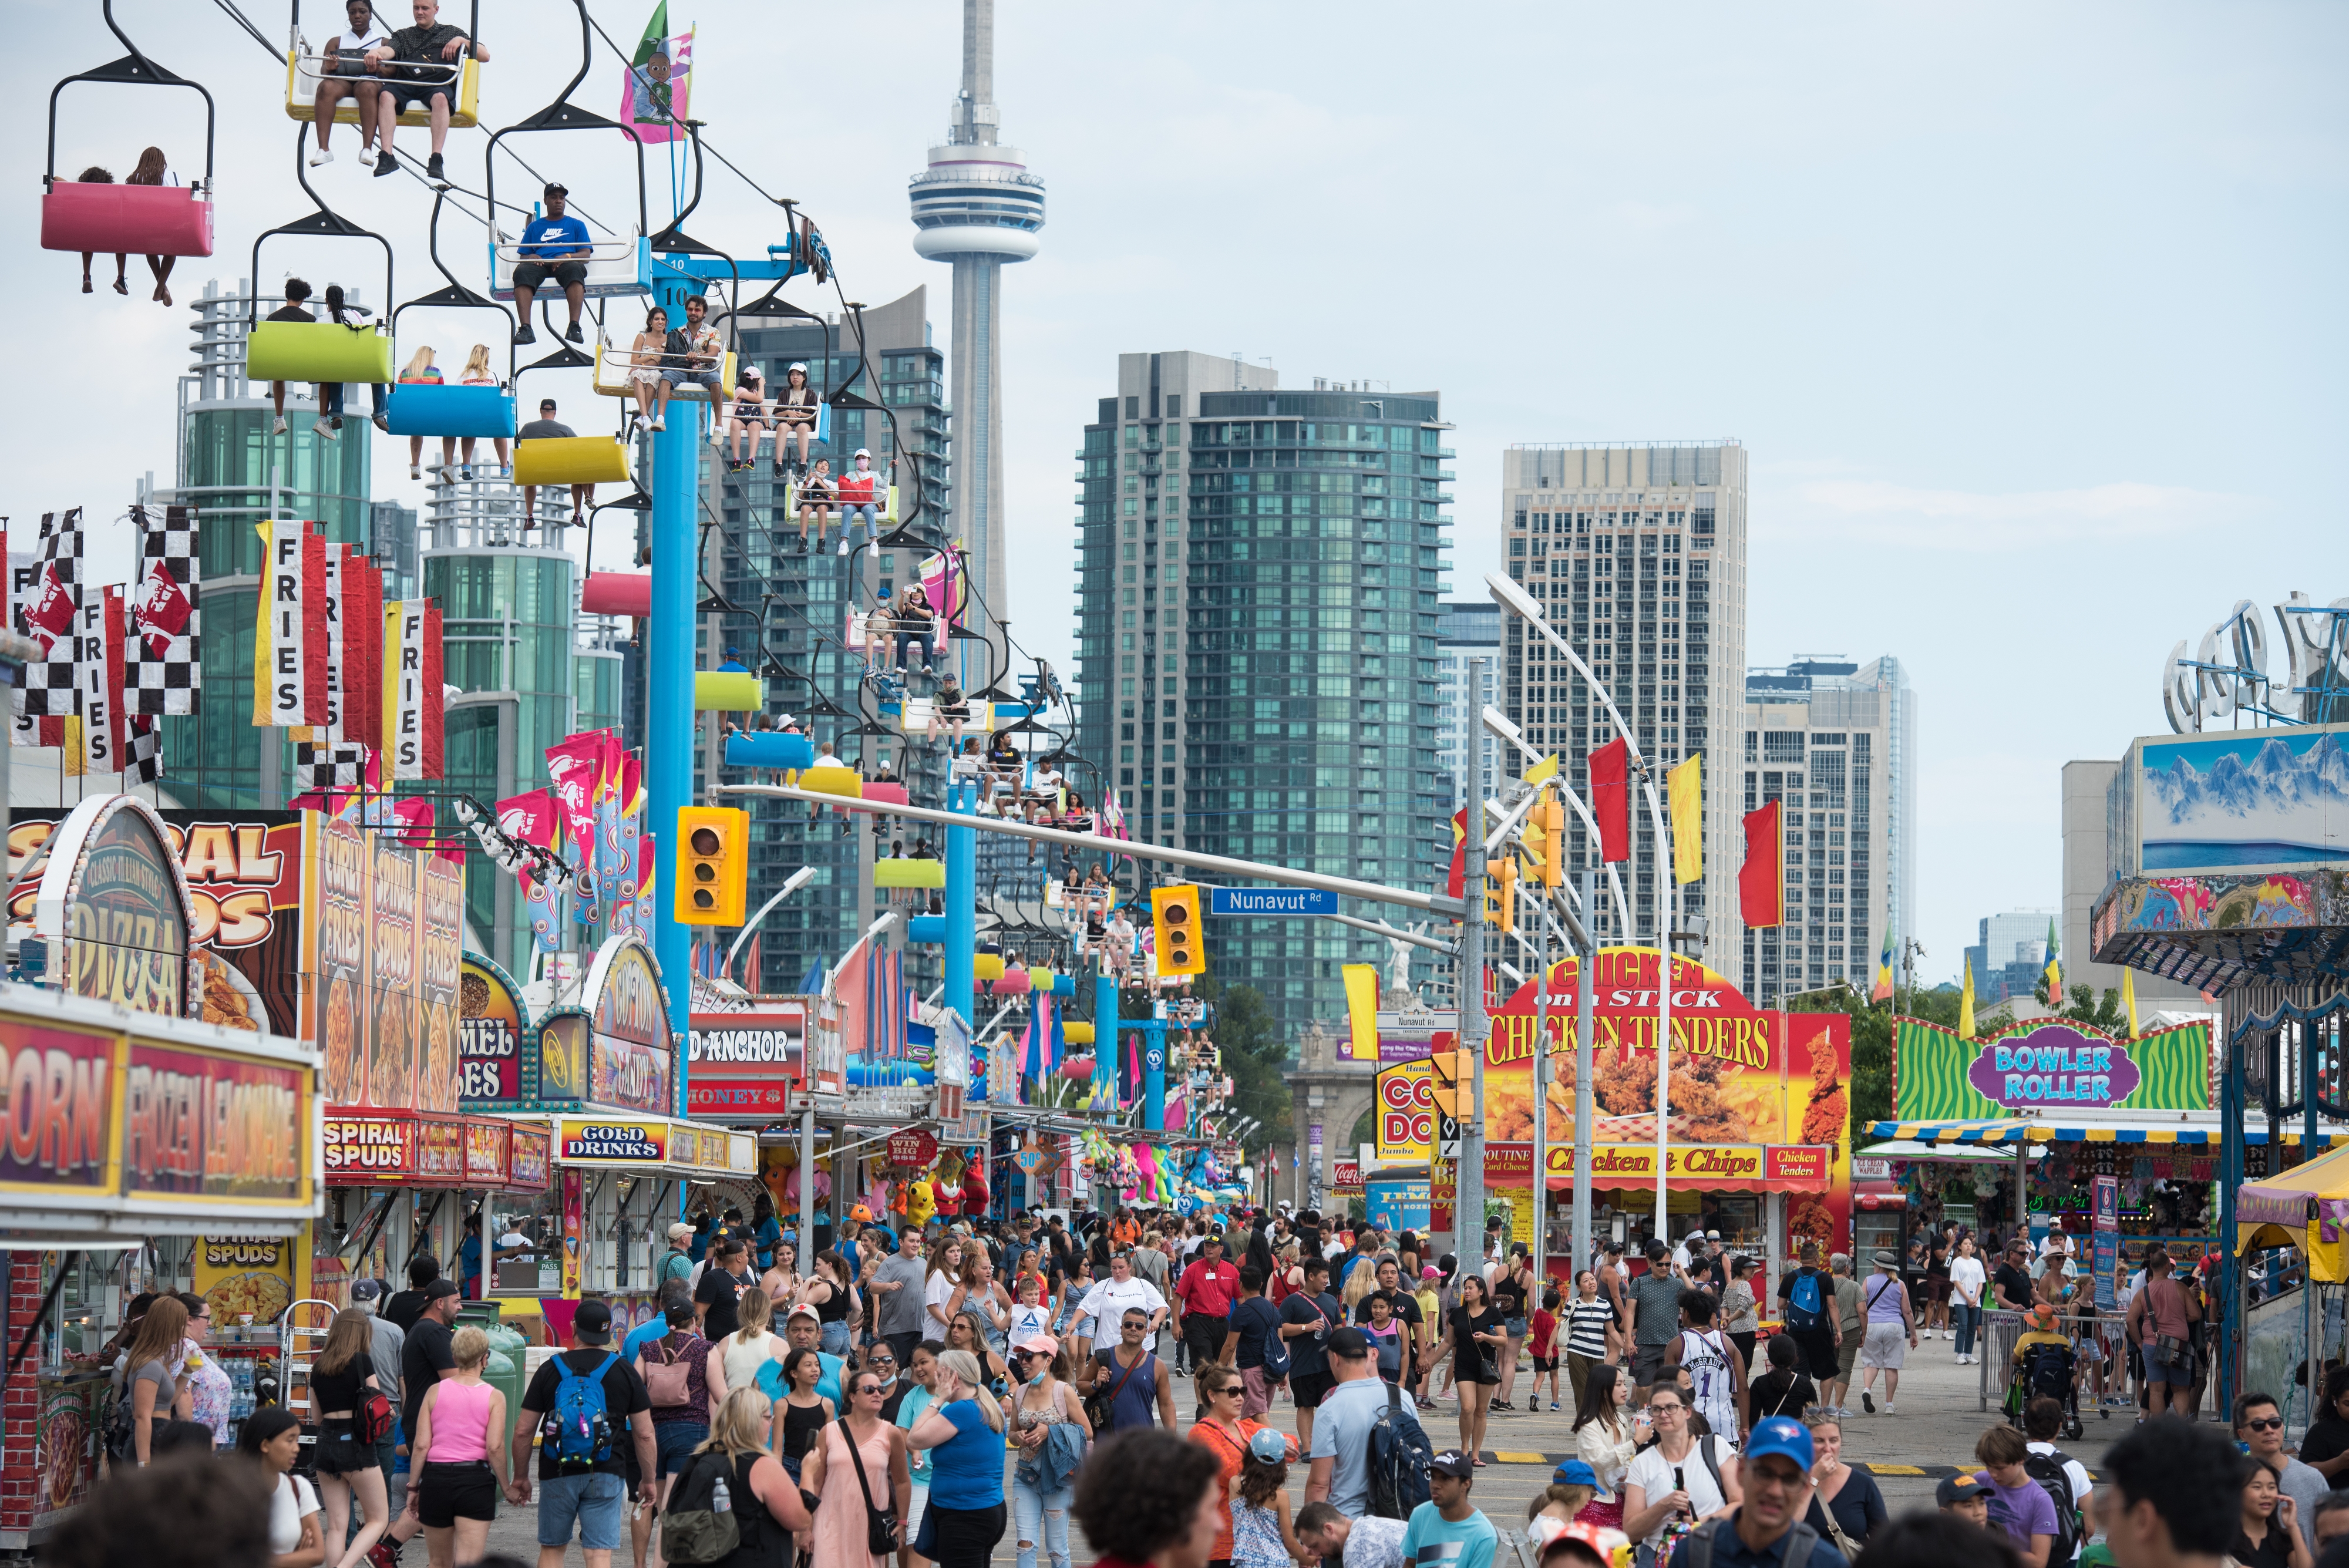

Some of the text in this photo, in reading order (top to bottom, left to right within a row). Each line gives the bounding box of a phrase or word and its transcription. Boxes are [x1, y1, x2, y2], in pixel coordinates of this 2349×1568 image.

[544, 228, 564, 236] NIKE
[671, 259, 685, 270] 10
[664, 287, 686, 306] 10
[277, 538, 298, 711] FRIES
[85, 604, 107, 760] FRIES
[399, 615, 420, 765] FRIES
[90, 855, 116, 888] CLASSIC
[141, 862, 159, 900] STYLE
[325, 829, 362, 904] CURLY
[376, 848, 413, 922] SPIRAL
[1230, 892, 1322, 910] Nunavut Rd
[324, 901, 362, 971] FRIES
[69, 901, 178, 1018] PIZZA
[375, 918, 412, 985] SPUDS
[426, 928, 457, 993] FRIES
[615, 962, 652, 1033] COTTON
[1608, 990, 1722, 1008] STCK
[1398, 1017, 1425, 1026] Nunavut
[706, 1029, 788, 1062] ANCHOR
[1152, 1032, 1160, 1041] 13
[1486, 1014, 1621, 1066] CHICKEN
[1995, 1046, 2113, 1072] BOWLER
[618, 1049, 649, 1098] CANDY
[2005, 1075, 2112, 1101] ROLLER
[323, 1122, 403, 1145] SPIRAL
[581, 1126, 645, 1141] COLD
[325, 1145, 402, 1167] SPUDS
[568, 1140, 658, 1156] DRINKS
[1379, 1148, 1414, 1156] Jumbo
[1776, 1150, 1816, 1163] Chicken
[2146, 1143, 2172, 1153] MAD
[1483, 1162, 1529, 1171] Curd Cheese
[1684, 1149, 1757, 1177] Chips
[1779, 1164, 1815, 1176] Tenders
[2104, 1189, 2109, 1206] 6
[207, 1245, 277, 1263] SPUDS
[1688, 1357, 1723, 1372] McGRADY
[1699, 1373, 1712, 1397] 1
[46, 1399, 60, 1416] CLASSIC
[60, 1398, 72, 1408] ITALIAN
